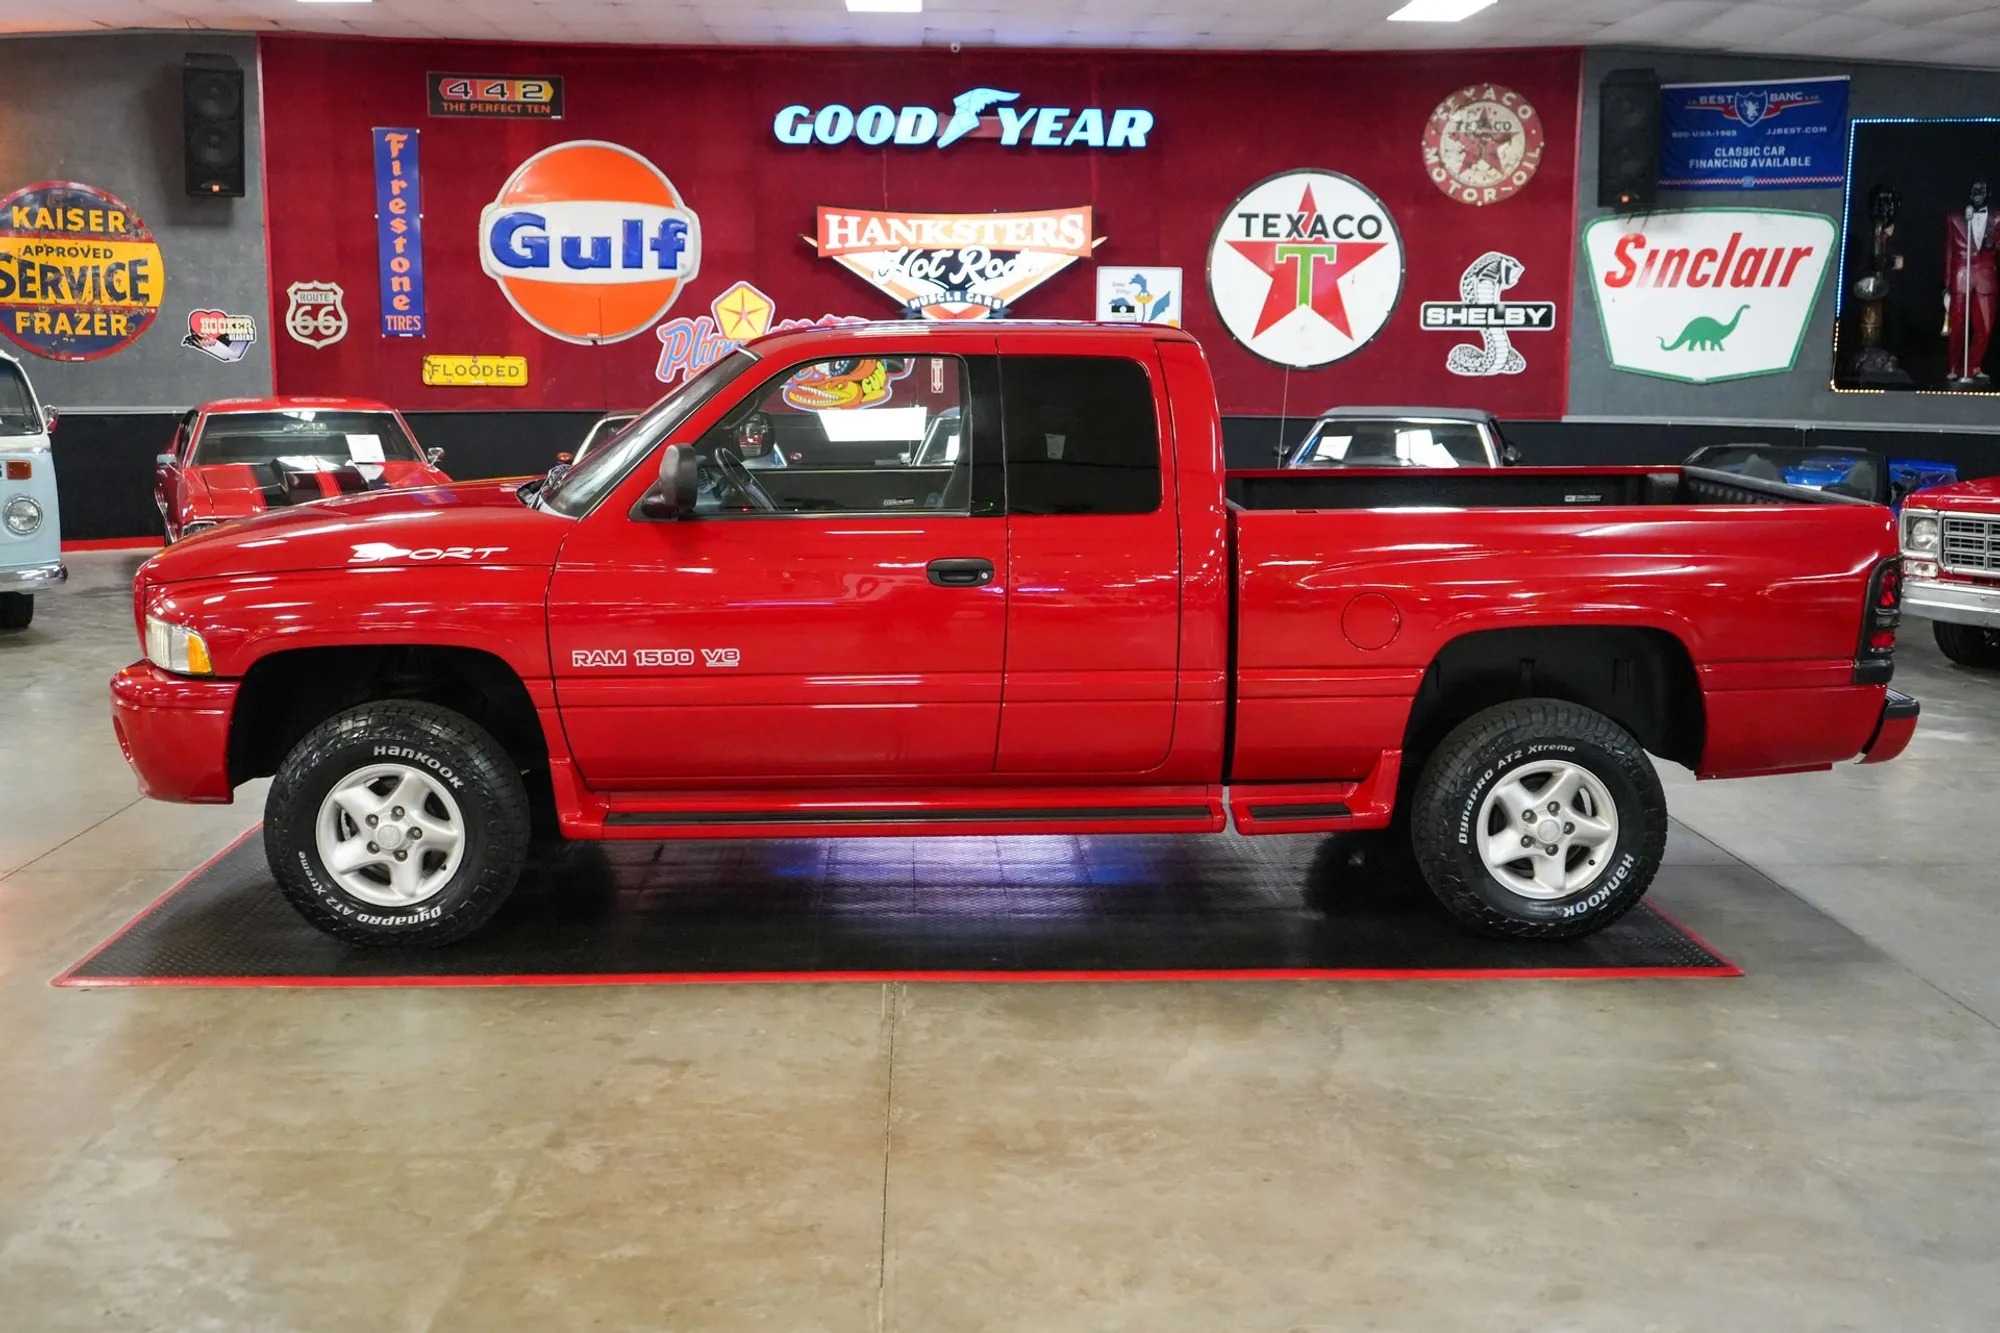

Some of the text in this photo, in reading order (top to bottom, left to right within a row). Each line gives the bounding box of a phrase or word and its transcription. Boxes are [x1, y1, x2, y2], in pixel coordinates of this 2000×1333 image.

[442, 102, 551, 114] THE PERFECT TEN
[1688, 156, 1812, 169] FINANCING AVAILABLE
[1714, 145, 1786, 158] CLASSIC CAR
[11, 205, 127, 233] KAISER
[384, 132, 412, 311] Firestone
[1238, 211, 1383, 241] TEXACO
[489, 211, 688, 270] Gulf
[824, 213, 1085, 251] HANKSTERS
[22, 244, 114, 259] APPROVED
[1604, 231, 1814, 289] Sinclair
[0, 252, 150, 303] SERVICE
[300, 292, 330, 302] ROUTE
[909, 290, 1002, 310] MUSCLE CARS
[14, 311, 129, 337] FRAZER
[294, 304, 337, 336] 66
[385, 315, 422, 332] TIRES
[1426, 306, 1548, 326] SHELBY
[431, 364, 520, 378] FLOODED
[572, 647, 741, 667] RAM 1500 V8
[1498, 749, 1523, 770] AT2
[1527, 743, 1576, 755] Xtreme
[297, 850, 328, 897] Xtreme
[325, 895, 356, 917] AT2
